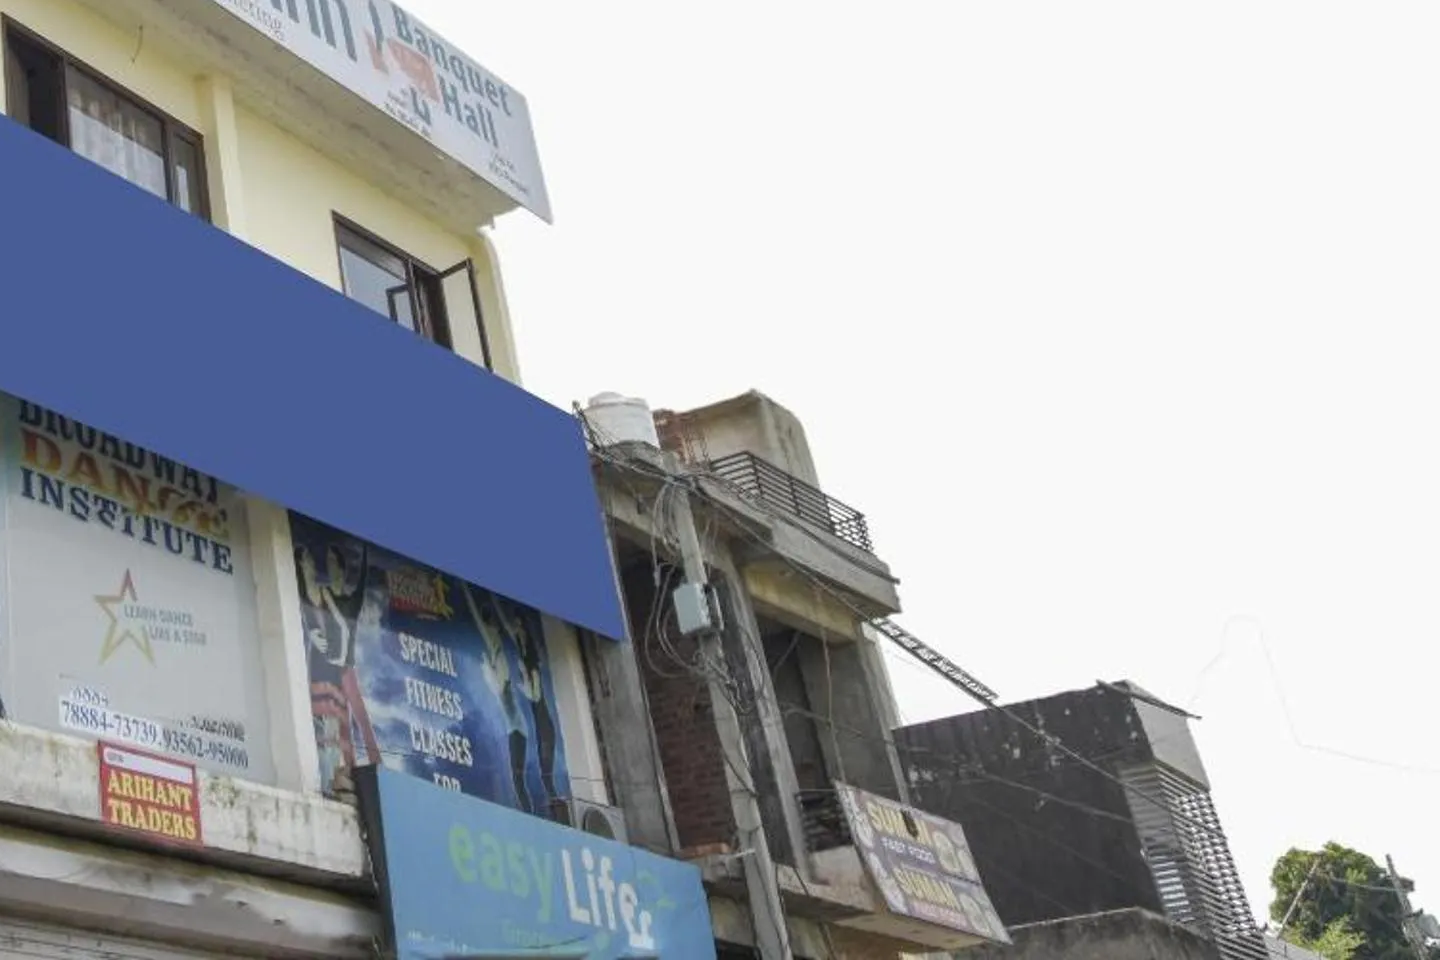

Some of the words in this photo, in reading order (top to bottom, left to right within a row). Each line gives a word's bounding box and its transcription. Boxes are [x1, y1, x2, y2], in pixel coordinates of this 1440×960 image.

[392, 3, 513, 117] Banquet
[439, 74, 499, 147] Hall
[20, 427, 230, 538] DANCE
[20, 466, 234, 575] INSTITUTE
[398, 632, 458, 678] SPECIAL
[405, 676, 463, 721] FITNESS
[410, 722, 473, 768] CLASSES
[108, 769, 193, 811] ARIHANT
[108, 798, 196, 840] TRADERS
